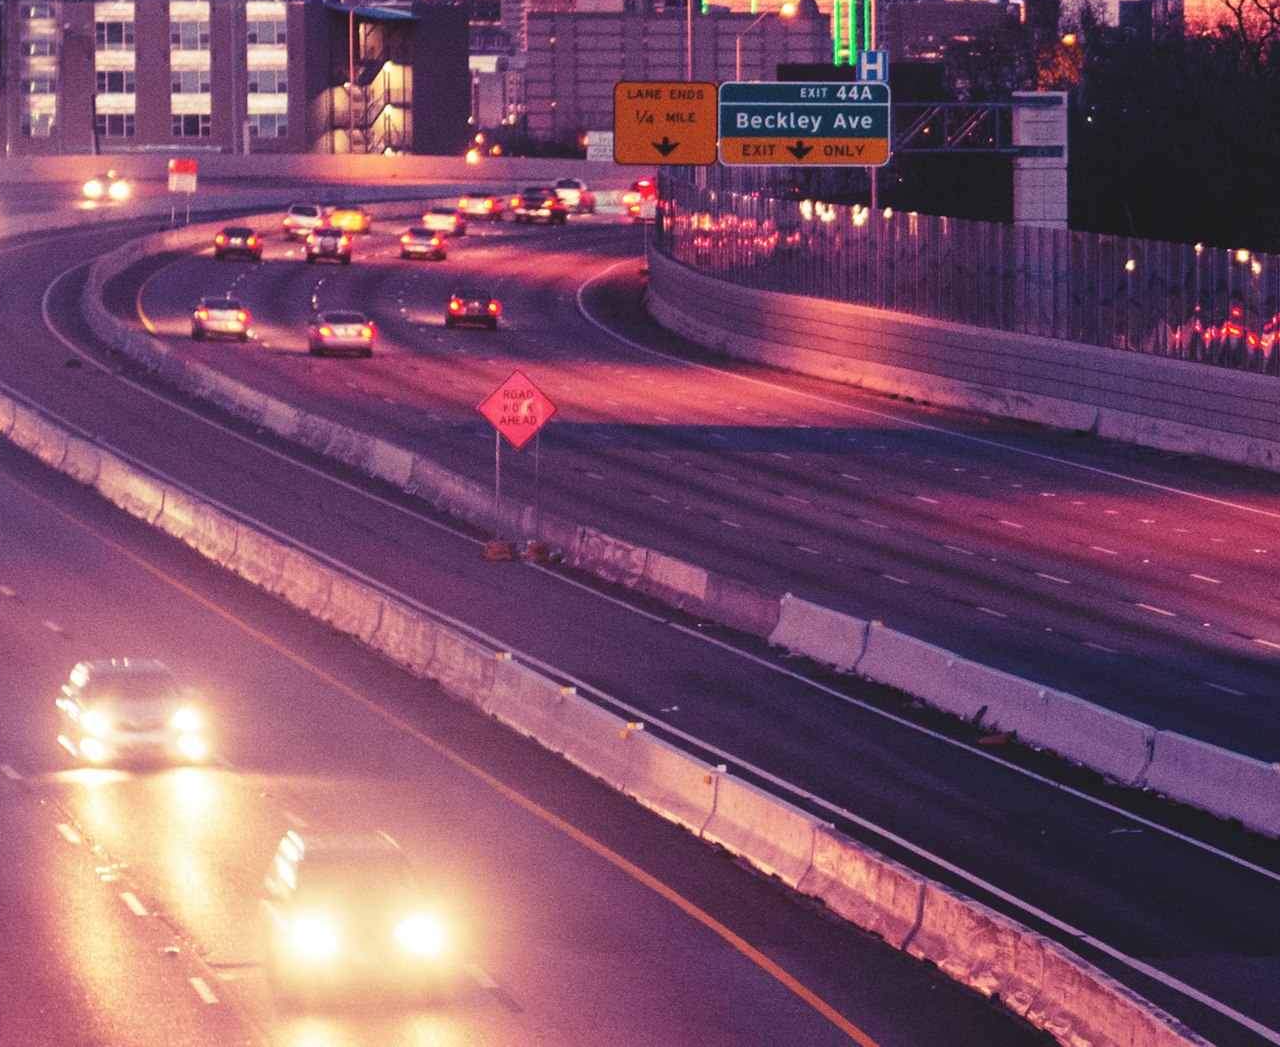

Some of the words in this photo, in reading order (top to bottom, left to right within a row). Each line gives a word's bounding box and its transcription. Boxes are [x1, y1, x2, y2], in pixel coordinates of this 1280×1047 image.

[860, 52, 883, 80] H
[627, 89, 662, 100] LANE
[669, 89, 704, 100] ENDS
[800, 87, 828, 98] EXIT
[836, 85, 872, 100] 44A
[665, 112, 696, 123] MILE
[735, 111, 822, 132] Beckley
[833, 113, 872, 129] Ave
[742, 144, 776, 156] EXIT
[823, 144, 865, 157] ONLY
[502, 389, 534, 400] ROAD
[503, 402, 533, 413] WOK
[500, 415, 537, 426] AHEAD
